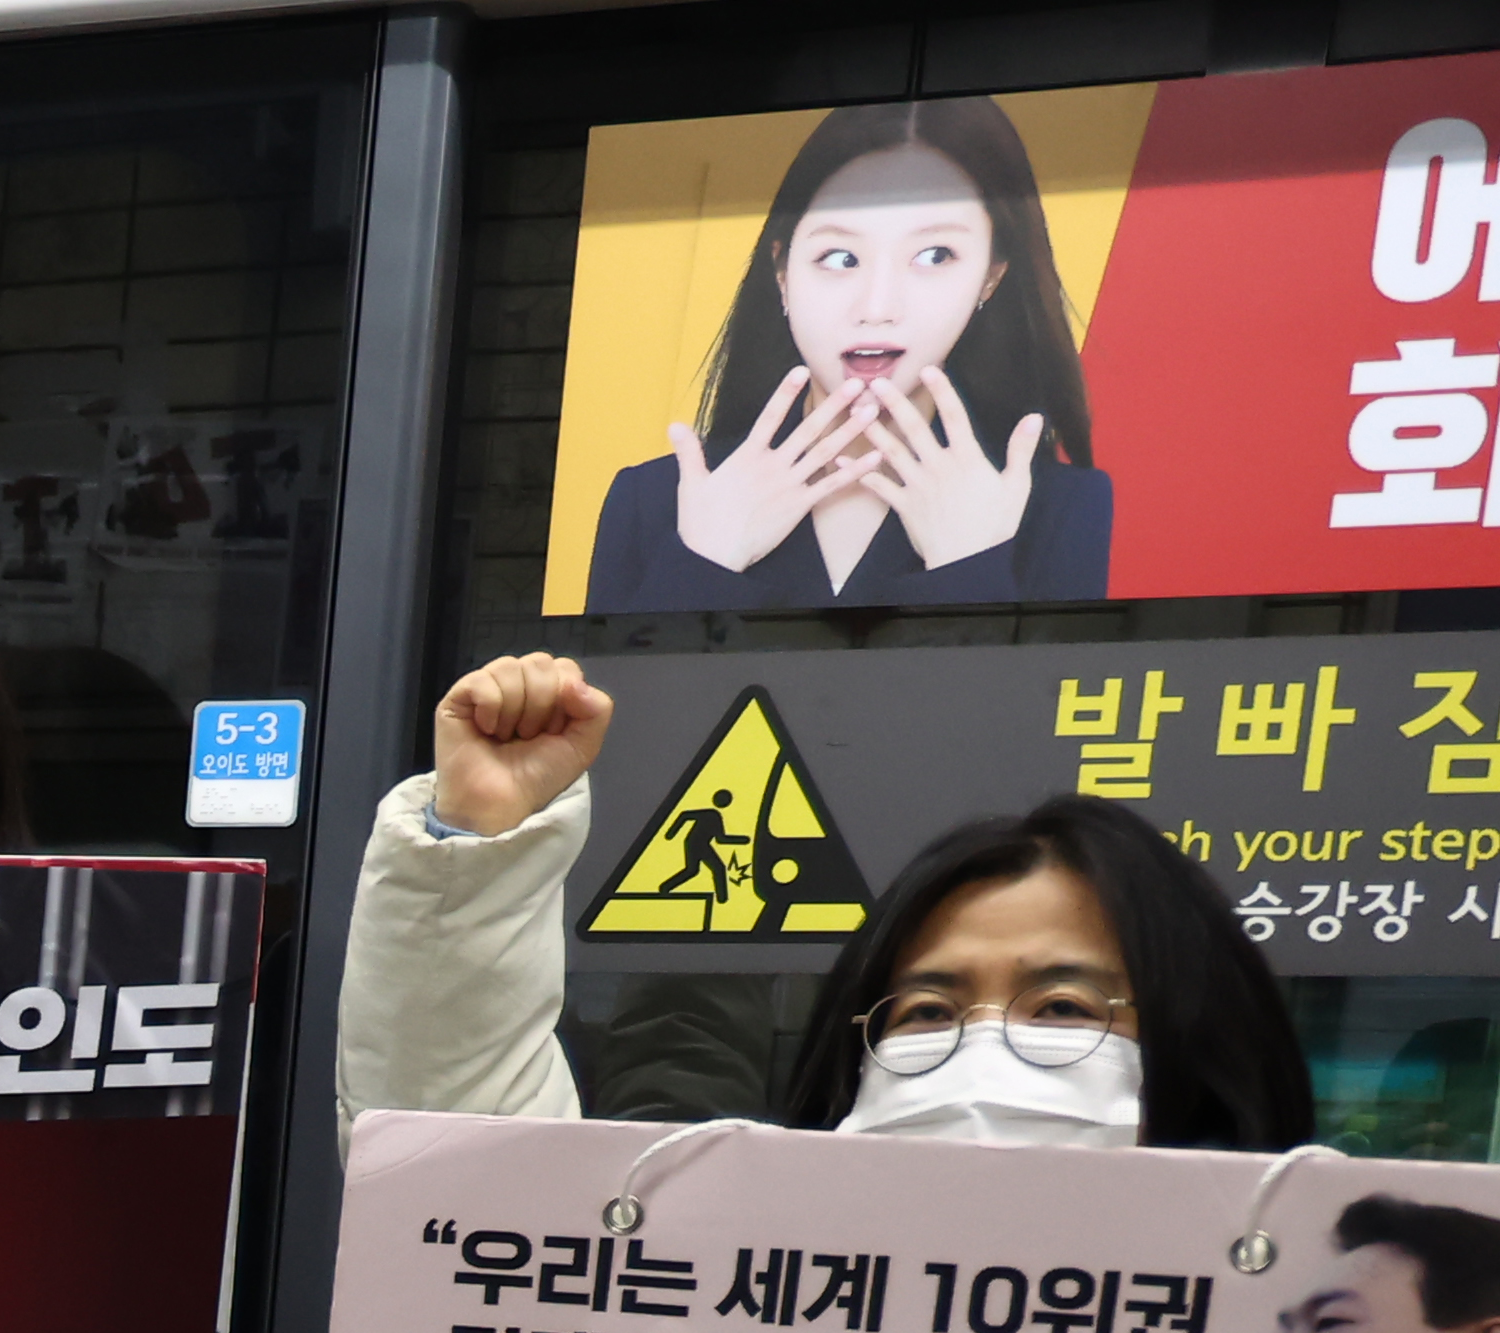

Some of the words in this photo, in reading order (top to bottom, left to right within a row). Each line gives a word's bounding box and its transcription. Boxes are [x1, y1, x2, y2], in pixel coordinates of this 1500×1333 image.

[216, 711, 278, 745] 5-3
[1234, 829, 1363, 871] your
[1232, 881, 1425, 943] 승강장
[423, 1216, 698, 1320] “우리는
[716, 1245, 890, 1333] 세계
